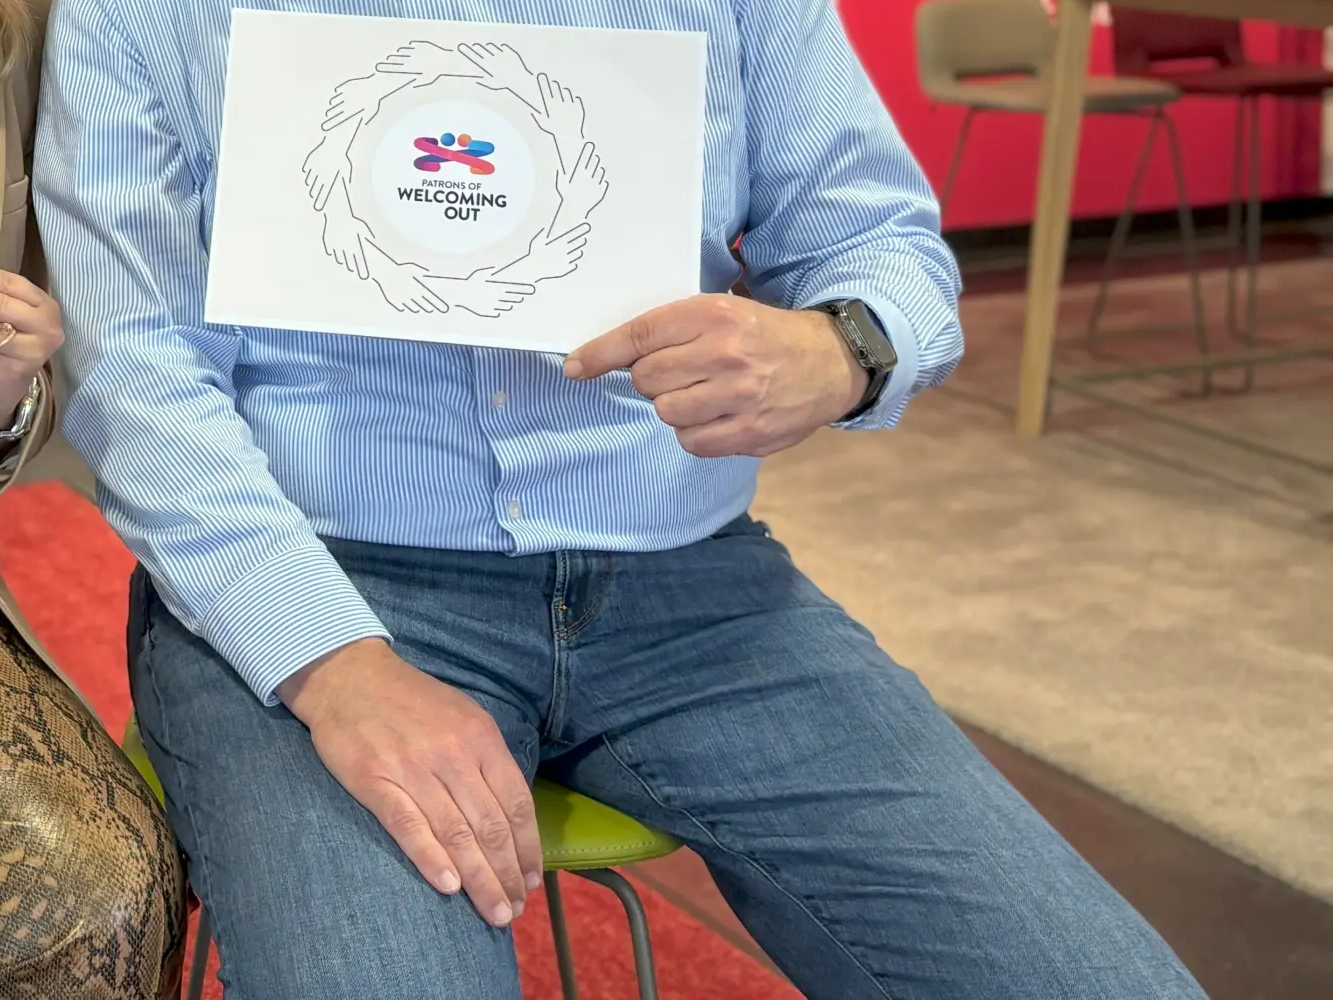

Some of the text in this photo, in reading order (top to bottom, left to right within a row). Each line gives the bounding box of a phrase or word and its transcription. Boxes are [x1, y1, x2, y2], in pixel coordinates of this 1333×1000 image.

[421, 178, 483, 191] PATRONS OF
[397, 187, 507, 208] WELCOMING
[443, 206, 481, 222] OUT
